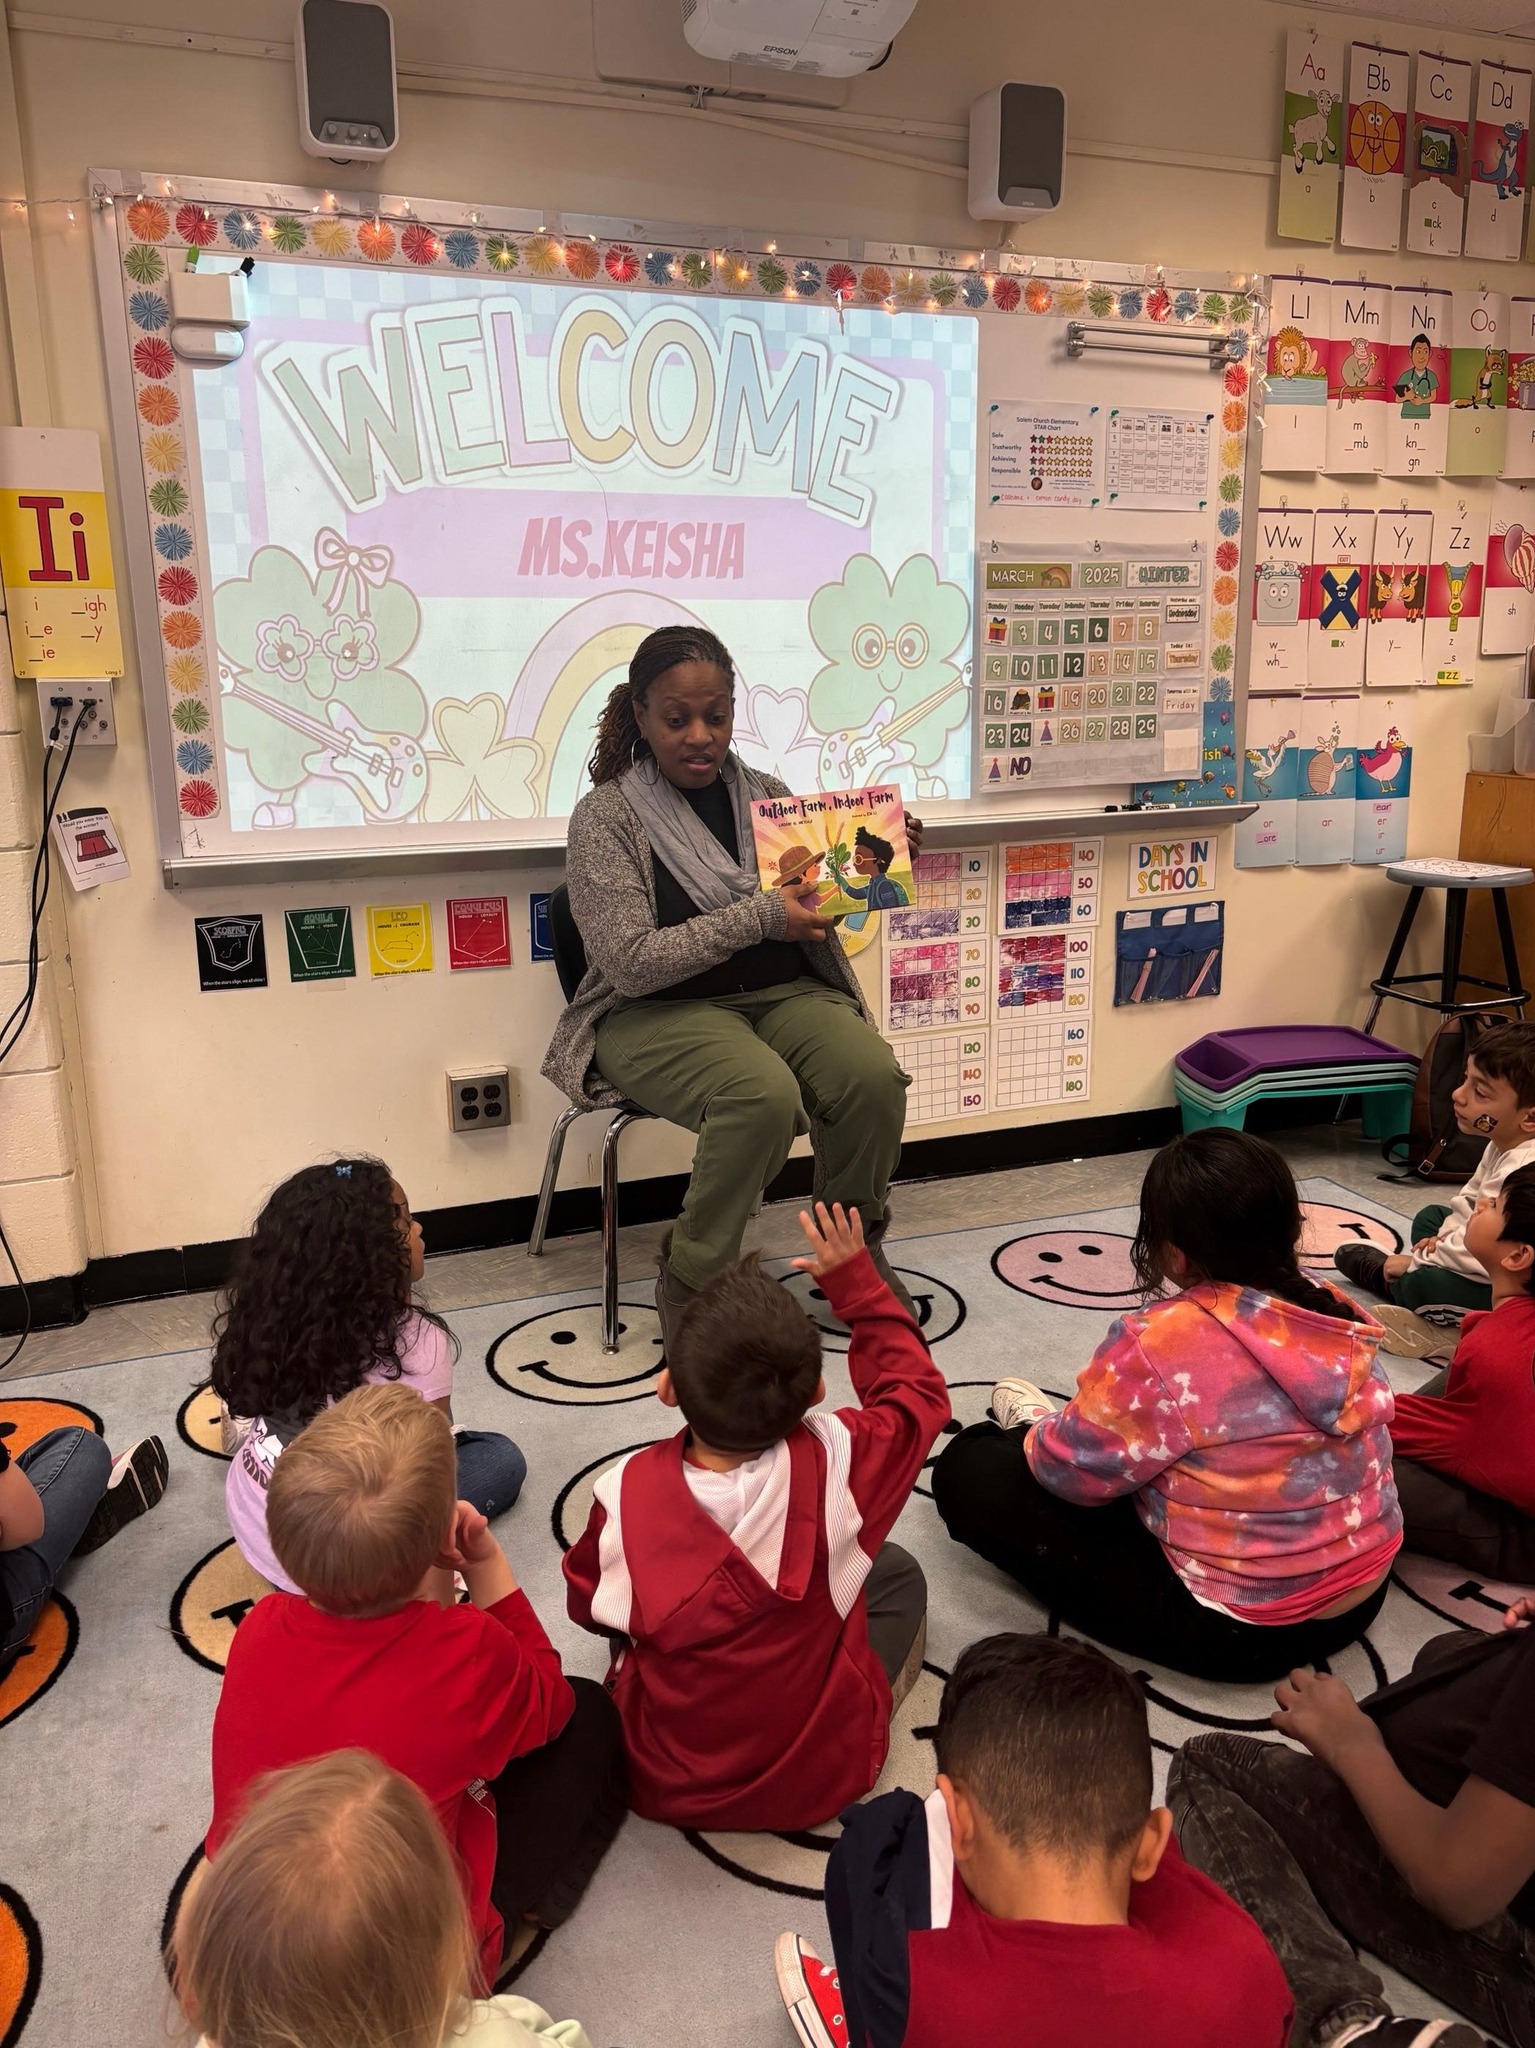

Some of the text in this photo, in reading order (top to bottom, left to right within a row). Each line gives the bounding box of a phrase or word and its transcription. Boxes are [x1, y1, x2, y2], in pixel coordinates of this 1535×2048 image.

[763, 45, 798, 56] EPSON
[1300, 53, 1325, 81] Aa
[1367, 63, 1390, 92] Bb
[1429, 74, 1453, 101] Cc
[1491, 81, 1514, 109] Dd
[1304, 184, 1311, 193] a
[1369, 188, 1376, 203] b
[1431, 201, 1437, 210] c
[1432, 215, 1442, 229] ck
[1490, 208, 1496, 222] d
[1429, 233, 1435, 247] k
[1291, 294, 1310, 320] Ll
[1345, 299, 1379, 326] Mm
[1411, 305, 1436, 330] Nn
[1470, 308, 1497, 333] Oo
[271, 309, 893, 519] WELCOME
[1050, 418, 1079, 426] Elementary
[1353, 421, 1362, 431] m
[1413, 422, 1420, 431] n
[1474, 426, 1481, 434] o
[991, 443, 1022, 452] Trustworthy
[991, 455, 1017, 463] Achieving
[1408, 457, 1420, 473] gn
[991, 467, 1021, 475] Responsible
[18, 495, 91, 581] Ii
[1264, 525, 1303, 548] Ww
[1332, 525, 1357, 549] Xx
[1393, 526, 1414, 559] Yy
[1449, 527, 1470, 549] Zz
[518, 515, 746, 580] MS.KEISHA
[992, 570, 1035, 582] MARCH
[1085, 568, 1119, 584] 2025
[1139, 565, 1189, 582] WINTER
[988, 602, 1008, 610] Sunday
[1014, 603, 1034, 611] Monday
[1039, 602, 1060, 610] Tuesday
[1115, 600, 1134, 608] Friday
[1507, 603, 1516, 616] sh
[1168, 609, 1198, 618] Wednesday
[1018, 625, 1028, 640] 3
[1044, 625, 1052, 640] 4
[1070, 624, 1078, 639] 5
[1094, 623, 1103, 638] 6
[1119, 622, 1127, 637] 7
[1144, 621, 1153, 636] 8
[1339, 640, 1345, 648] x
[1449, 638, 1454, 646] z
[1066, 656, 1081, 674] 12
[1091, 655, 1106, 671] 13
[1116, 654, 1130, 670] 14
[1140, 653, 1155, 669] 15
[1169, 654, 1199, 664] Thursday
[992, 660, 1001, 676] 9
[1014, 659, 1030, 676] 10
[1041, 659, 1054, 675] 11
[1064, 690, 1080, 707] 19
[1088, 688, 1106, 704] 20
[1115, 686, 1130, 702] 21
[1137, 685, 1155, 701] 22
[988, 694, 1003, 711] 16
[1165, 700, 1196, 711] Friday
[1062, 724, 1079, 739] 26
[1087, 722, 1105, 737] 27
[1112, 720, 1130, 736] 28
[1137, 718, 1155, 734] 29
[987, 728, 1005, 744] 23
[1012, 727, 1030, 743] 24
[1204, 747, 1222, 761] ish
[1009, 756, 1032, 776] NO
[759, 790, 894, 819] Outdoor Farm, Indoor Farm
[1376, 803, 1392, 811] ear
[1263, 819, 1274, 828] or
[1321, 818, 1333, 827] ar
[1377, 816, 1387, 826] er
[1377, 830, 1385, 839] ir
[1078, 850, 1095, 862] 40
[1138, 840, 1209, 868] DAYS IN
[1375, 846, 1386, 855] ur
[969, 859, 981, 872] 10
[1078, 877, 1093, 889] 50
[1137, 864, 1208, 894] SCHOOL
[966, 888, 982, 900] 20
[454, 901, 502, 915] EQUULEUS
[1077, 904, 1092, 916] 60
[303, 912, 334, 925] AQUILA
[390, 911, 408, 922] LEO
[965, 916, 981, 928] 30
[213, 925, 247, 935] SCORPIUS
[1069, 940, 1088, 953] 100
[966, 948, 981, 961] 70
[1070, 967, 1085, 979] 110
[965, 975, 981, 988] 80
[1068, 994, 1085, 1006] 120
[965, 1003, 980, 1016] 90
[1067, 1028, 1084, 1040] 160
[963, 1041, 981, 1054] 130
[1067, 1054, 1083, 1066] 170
[963, 1068, 982, 1080] 140
[1065, 1080, 1083, 1092] 180
[963, 1094, 981, 1106] 150
